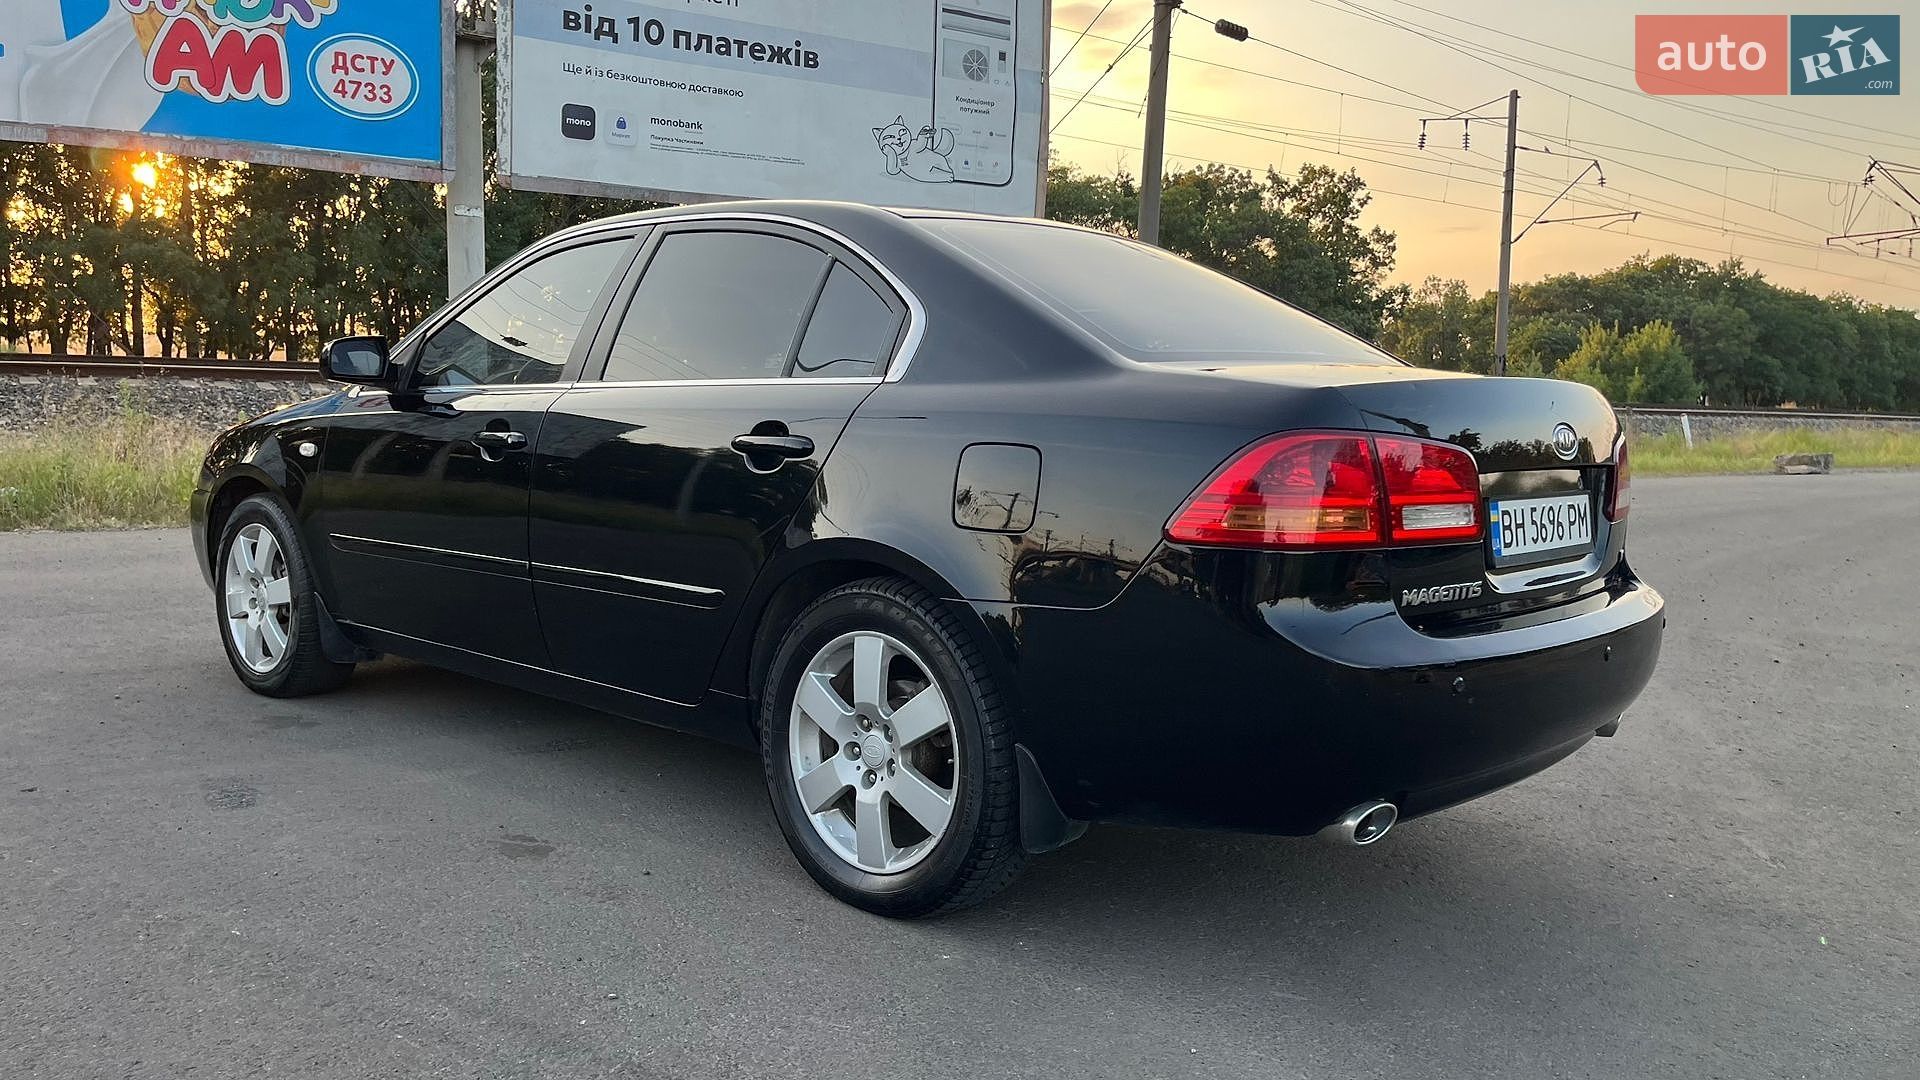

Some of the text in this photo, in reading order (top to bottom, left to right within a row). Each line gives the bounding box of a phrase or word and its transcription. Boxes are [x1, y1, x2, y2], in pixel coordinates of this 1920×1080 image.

[563, 4, 820, 69] від 10 платежів
[152, 17, 284, 100] АМ
[331, 51, 396, 76] ДСТУ
[332, 78, 393, 104] 4733
[562, 62, 744, 98] Ще й із безкоштовною доставкою
[565, 117, 592, 127] mono
[650, 117, 703, 130] monobank
[1502, 502, 1589, 549] BH 5696 PM
[1401, 580, 1483, 607] MAGENTIS
